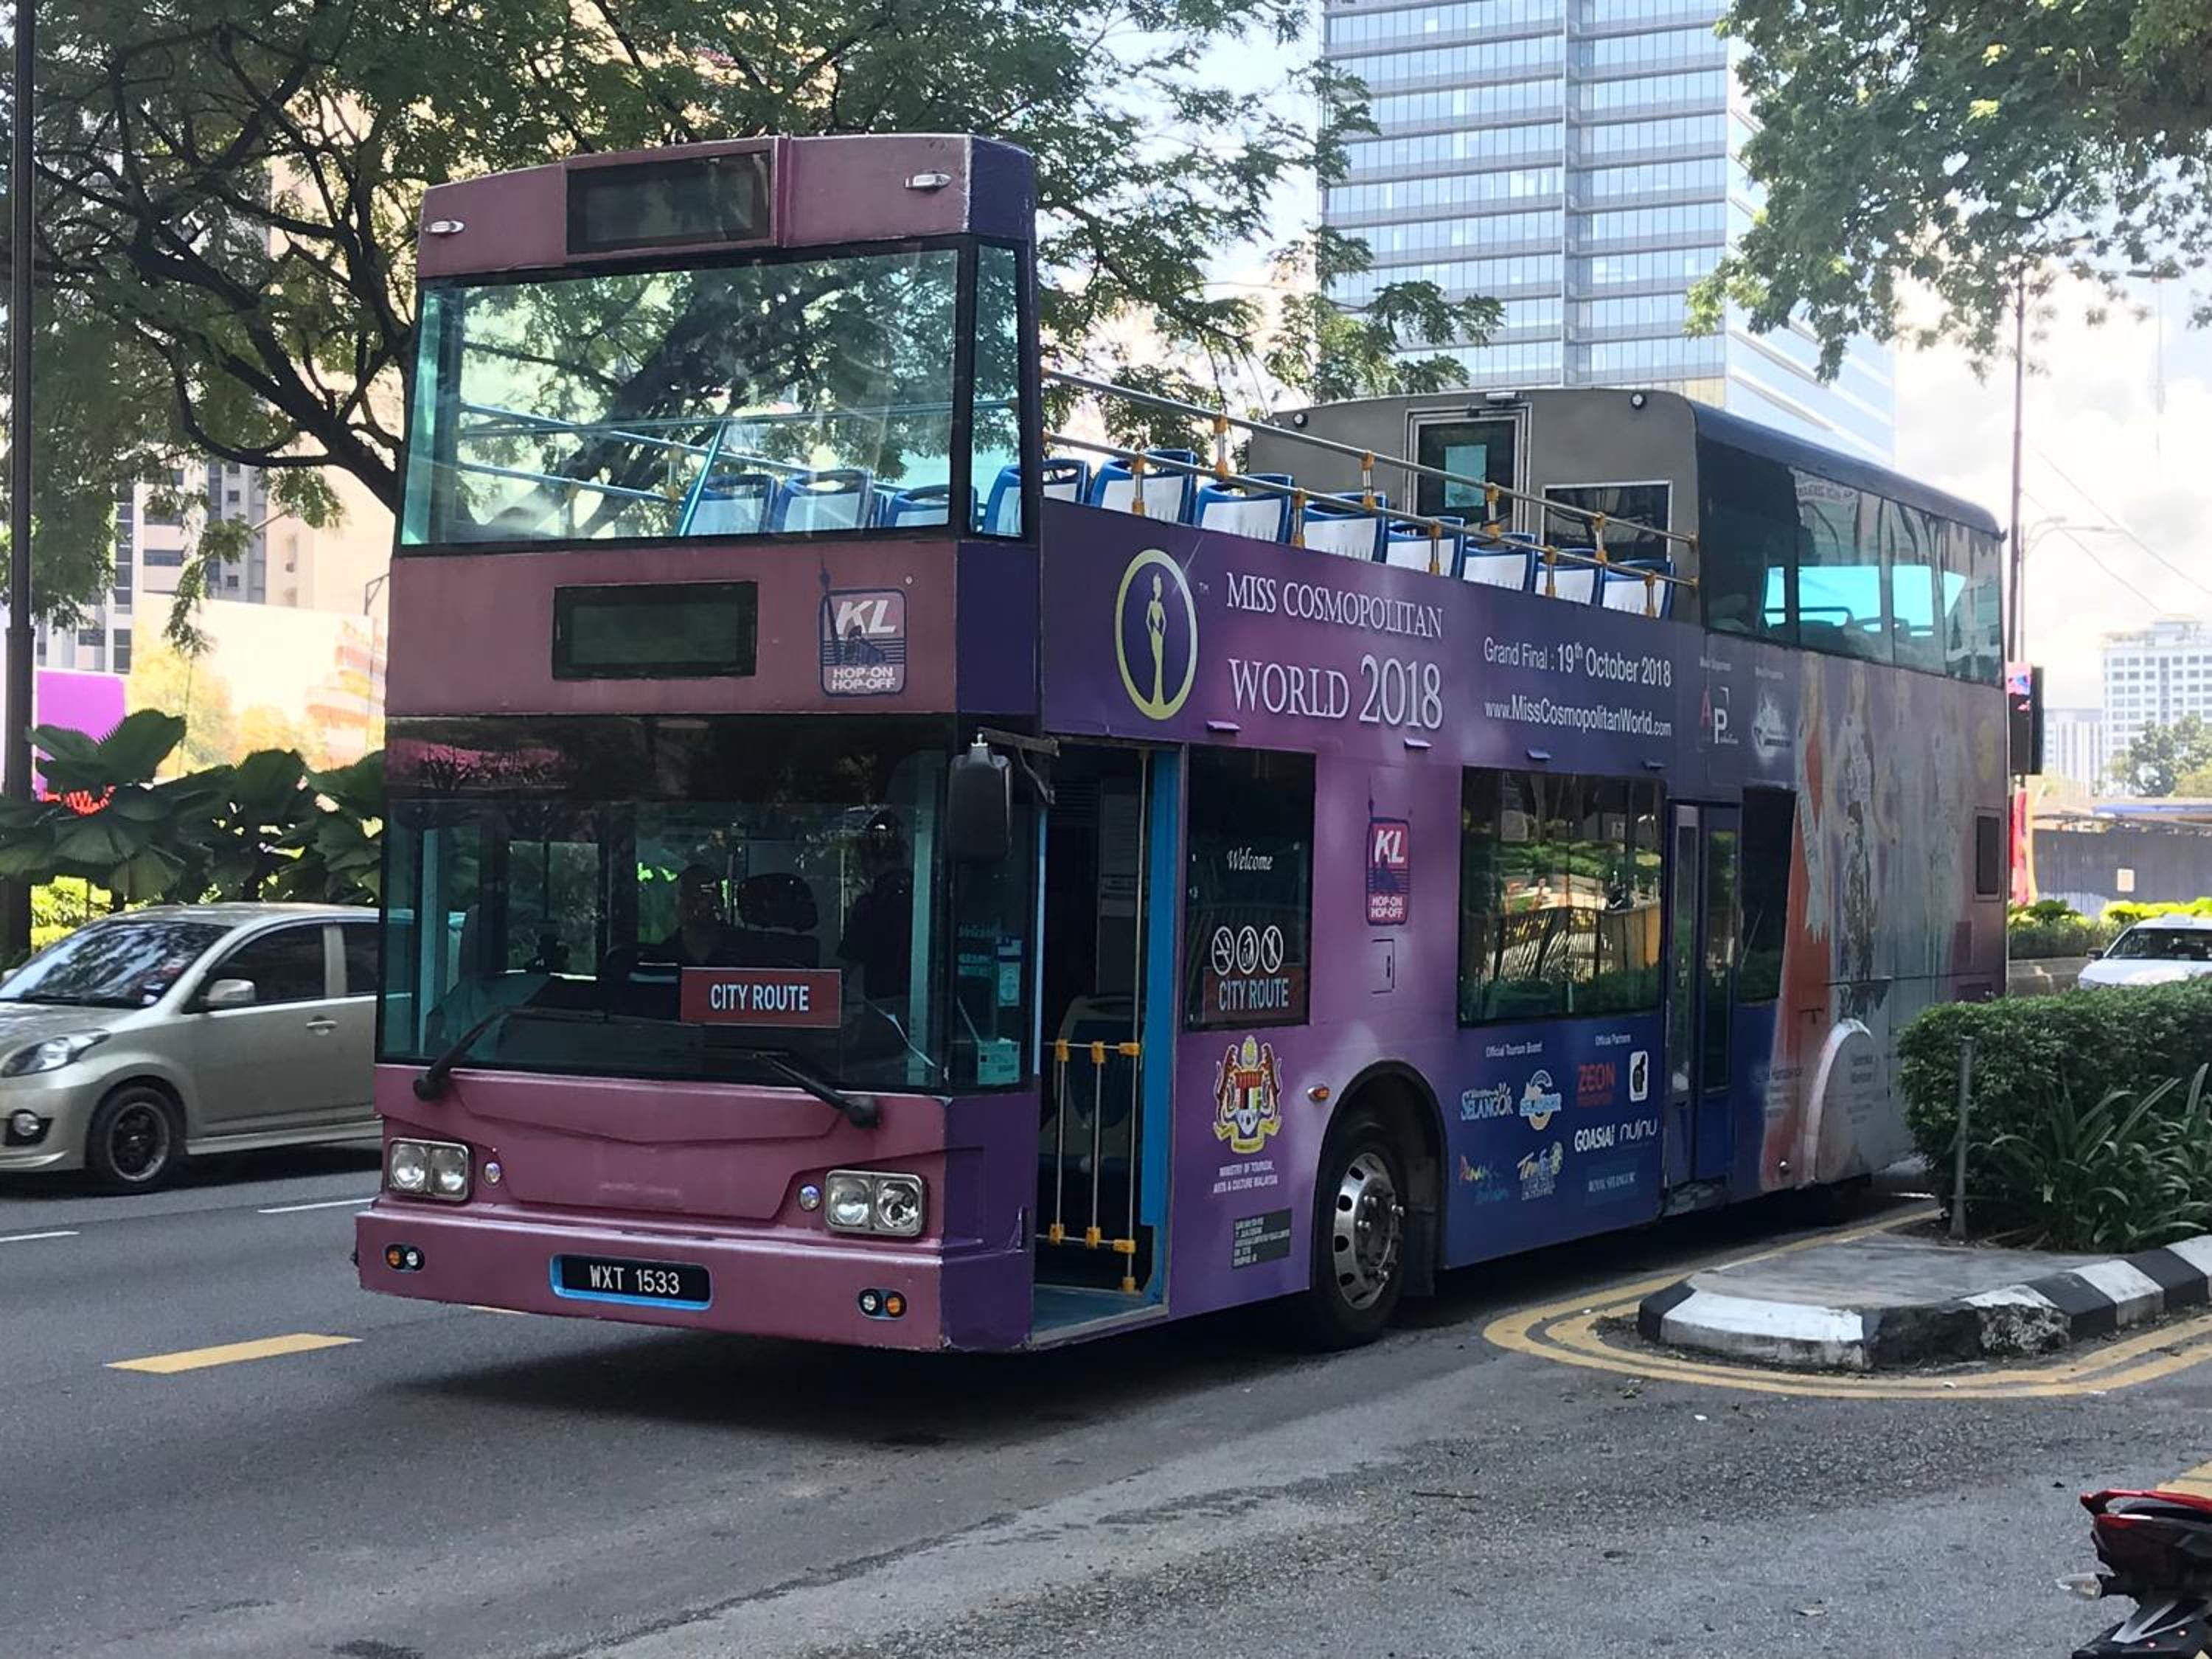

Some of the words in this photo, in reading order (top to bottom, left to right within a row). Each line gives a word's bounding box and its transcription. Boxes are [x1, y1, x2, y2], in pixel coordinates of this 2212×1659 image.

[835, 599, 897, 635] KL
[1226, 571, 1277, 613] MISS
[1283, 582, 1443, 639] COSMOPOLITAN
[832, 666, 893, 679] HOP-ON
[1484, 636, 1519, 666] Grand
[1522, 643, 1548, 670] Final
[1557, 641, 1584, 673] 19th
[1586, 647, 1638, 683] October
[1641, 655, 1672, 687] 2018
[831, 678, 897, 690] HOP-OFF
[1227, 658, 1350, 719] WORLD
[1359, 653, 1444, 728] 2018
[1484, 694, 1672, 737] www.MissCosmopolitanWorld.com
[1227, 847, 1274, 871] Welcome
[1374, 830, 1405, 863] KL
[1371, 896, 1403, 907] HOP-ON
[1371, 907, 1404, 919] HOP-OFF
[710, 983, 748, 1011] CITY
[752, 985, 810, 1012] ROUTE
[1219, 980, 1247, 1011] CITY
[1248, 978, 1289, 1010] ROUTE
[589, 1265, 625, 1290] WXT
[635, 1268, 681, 1295] 1533
